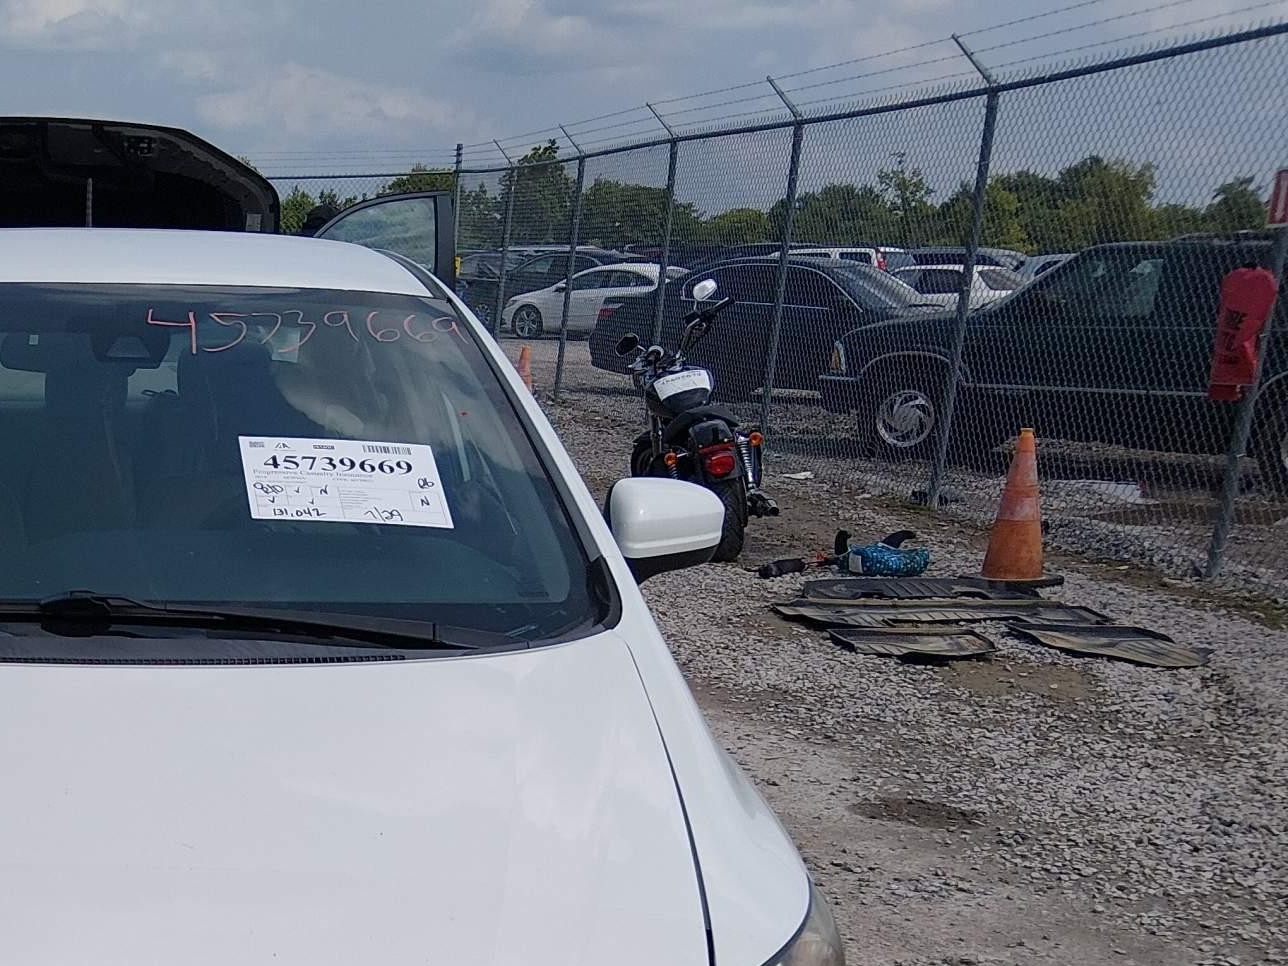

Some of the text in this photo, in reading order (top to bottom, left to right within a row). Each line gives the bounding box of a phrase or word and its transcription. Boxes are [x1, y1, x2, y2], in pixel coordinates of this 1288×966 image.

[146, 308, 469, 355] 45739669
[263, 454, 413, 476] 45739669
[363, 506, 404, 522] 7/29
